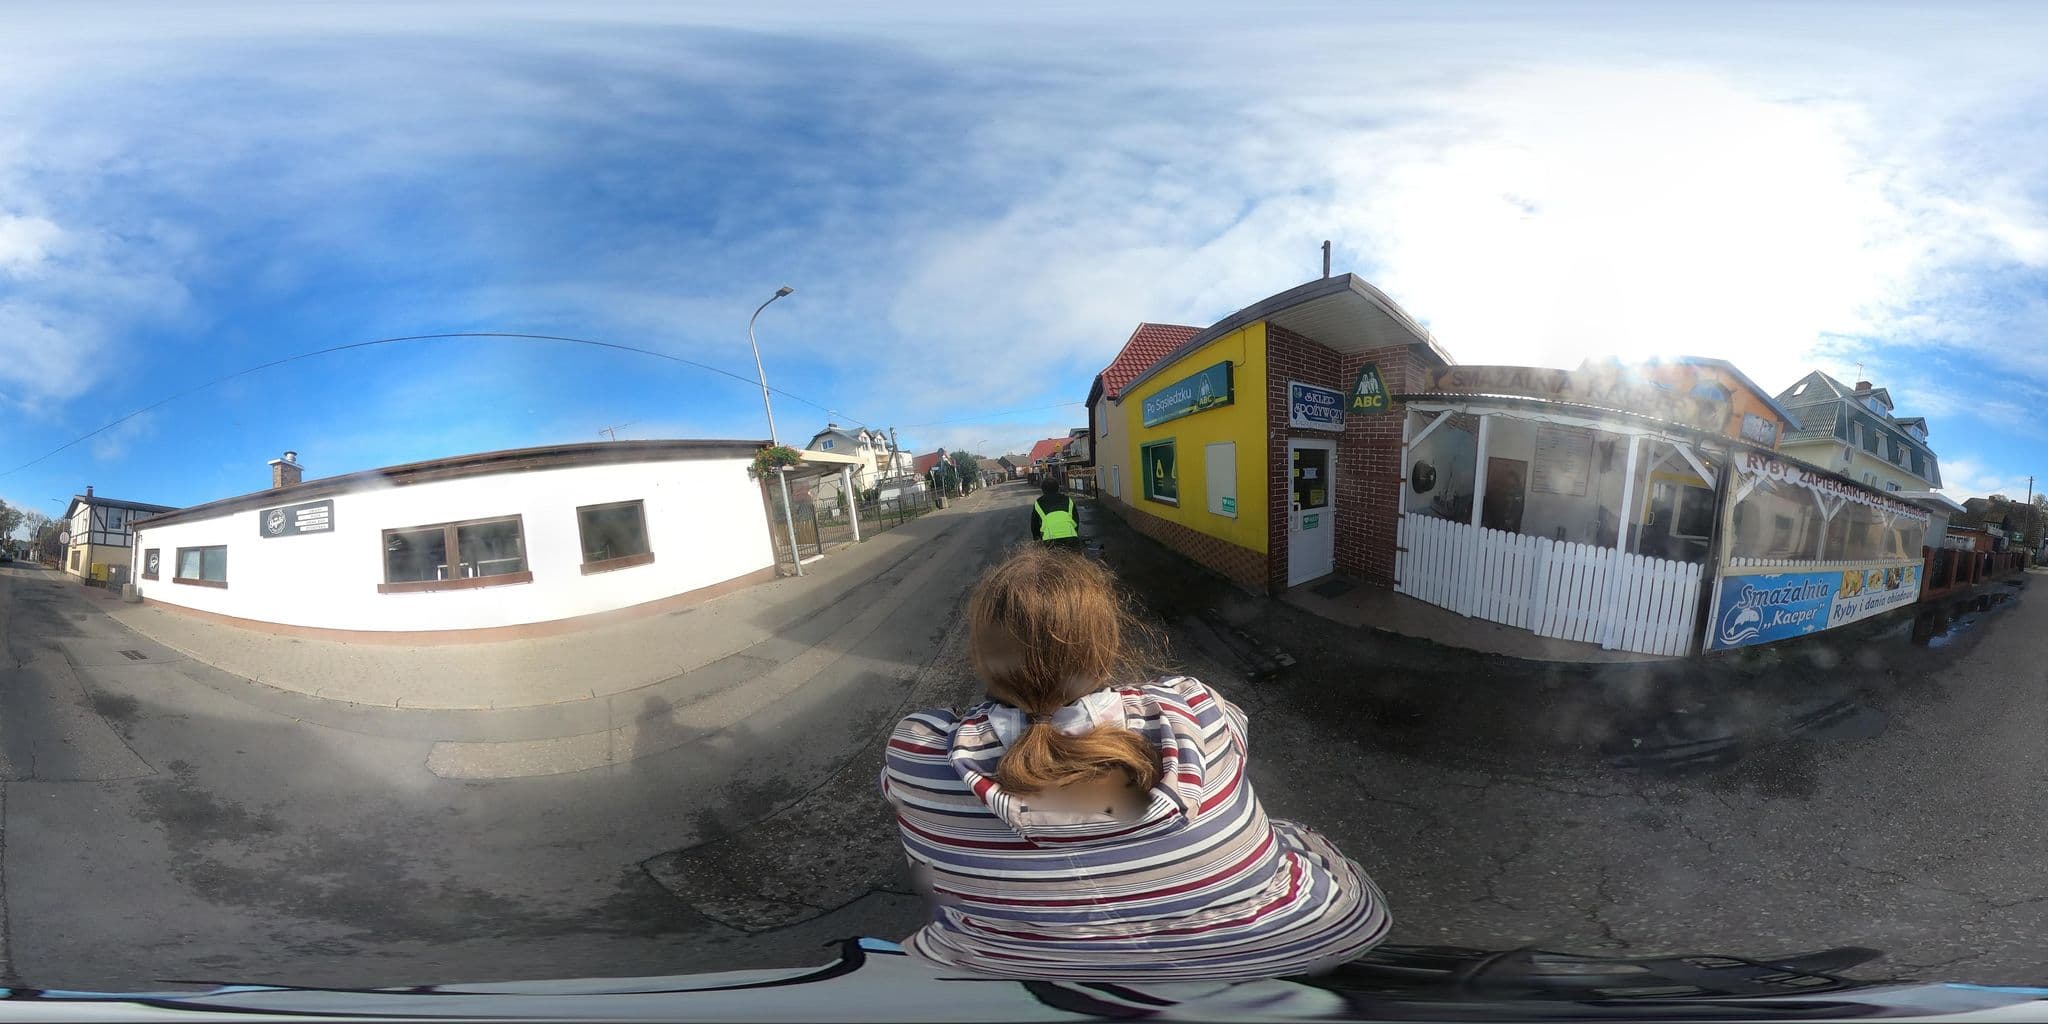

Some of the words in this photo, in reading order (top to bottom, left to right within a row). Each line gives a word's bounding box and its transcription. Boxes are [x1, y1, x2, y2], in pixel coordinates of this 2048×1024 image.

[1147, 403, 1155, 415] Po
[1200, 394, 1213, 405] ABC
[1353, 395, 1382, 408] ABC
[1747, 453, 1790, 478] RYBY
[1799, 471, 1861, 498] ZAPIEKANKI
[1865, 490, 1884, 505] PIZZA
[1738, 579, 1829, 608] Smażalnia
[1833, 601, 1857, 621] Ryby
[1860, 599, 1864, 612] i
[1865, 593, 1886, 610] dania
